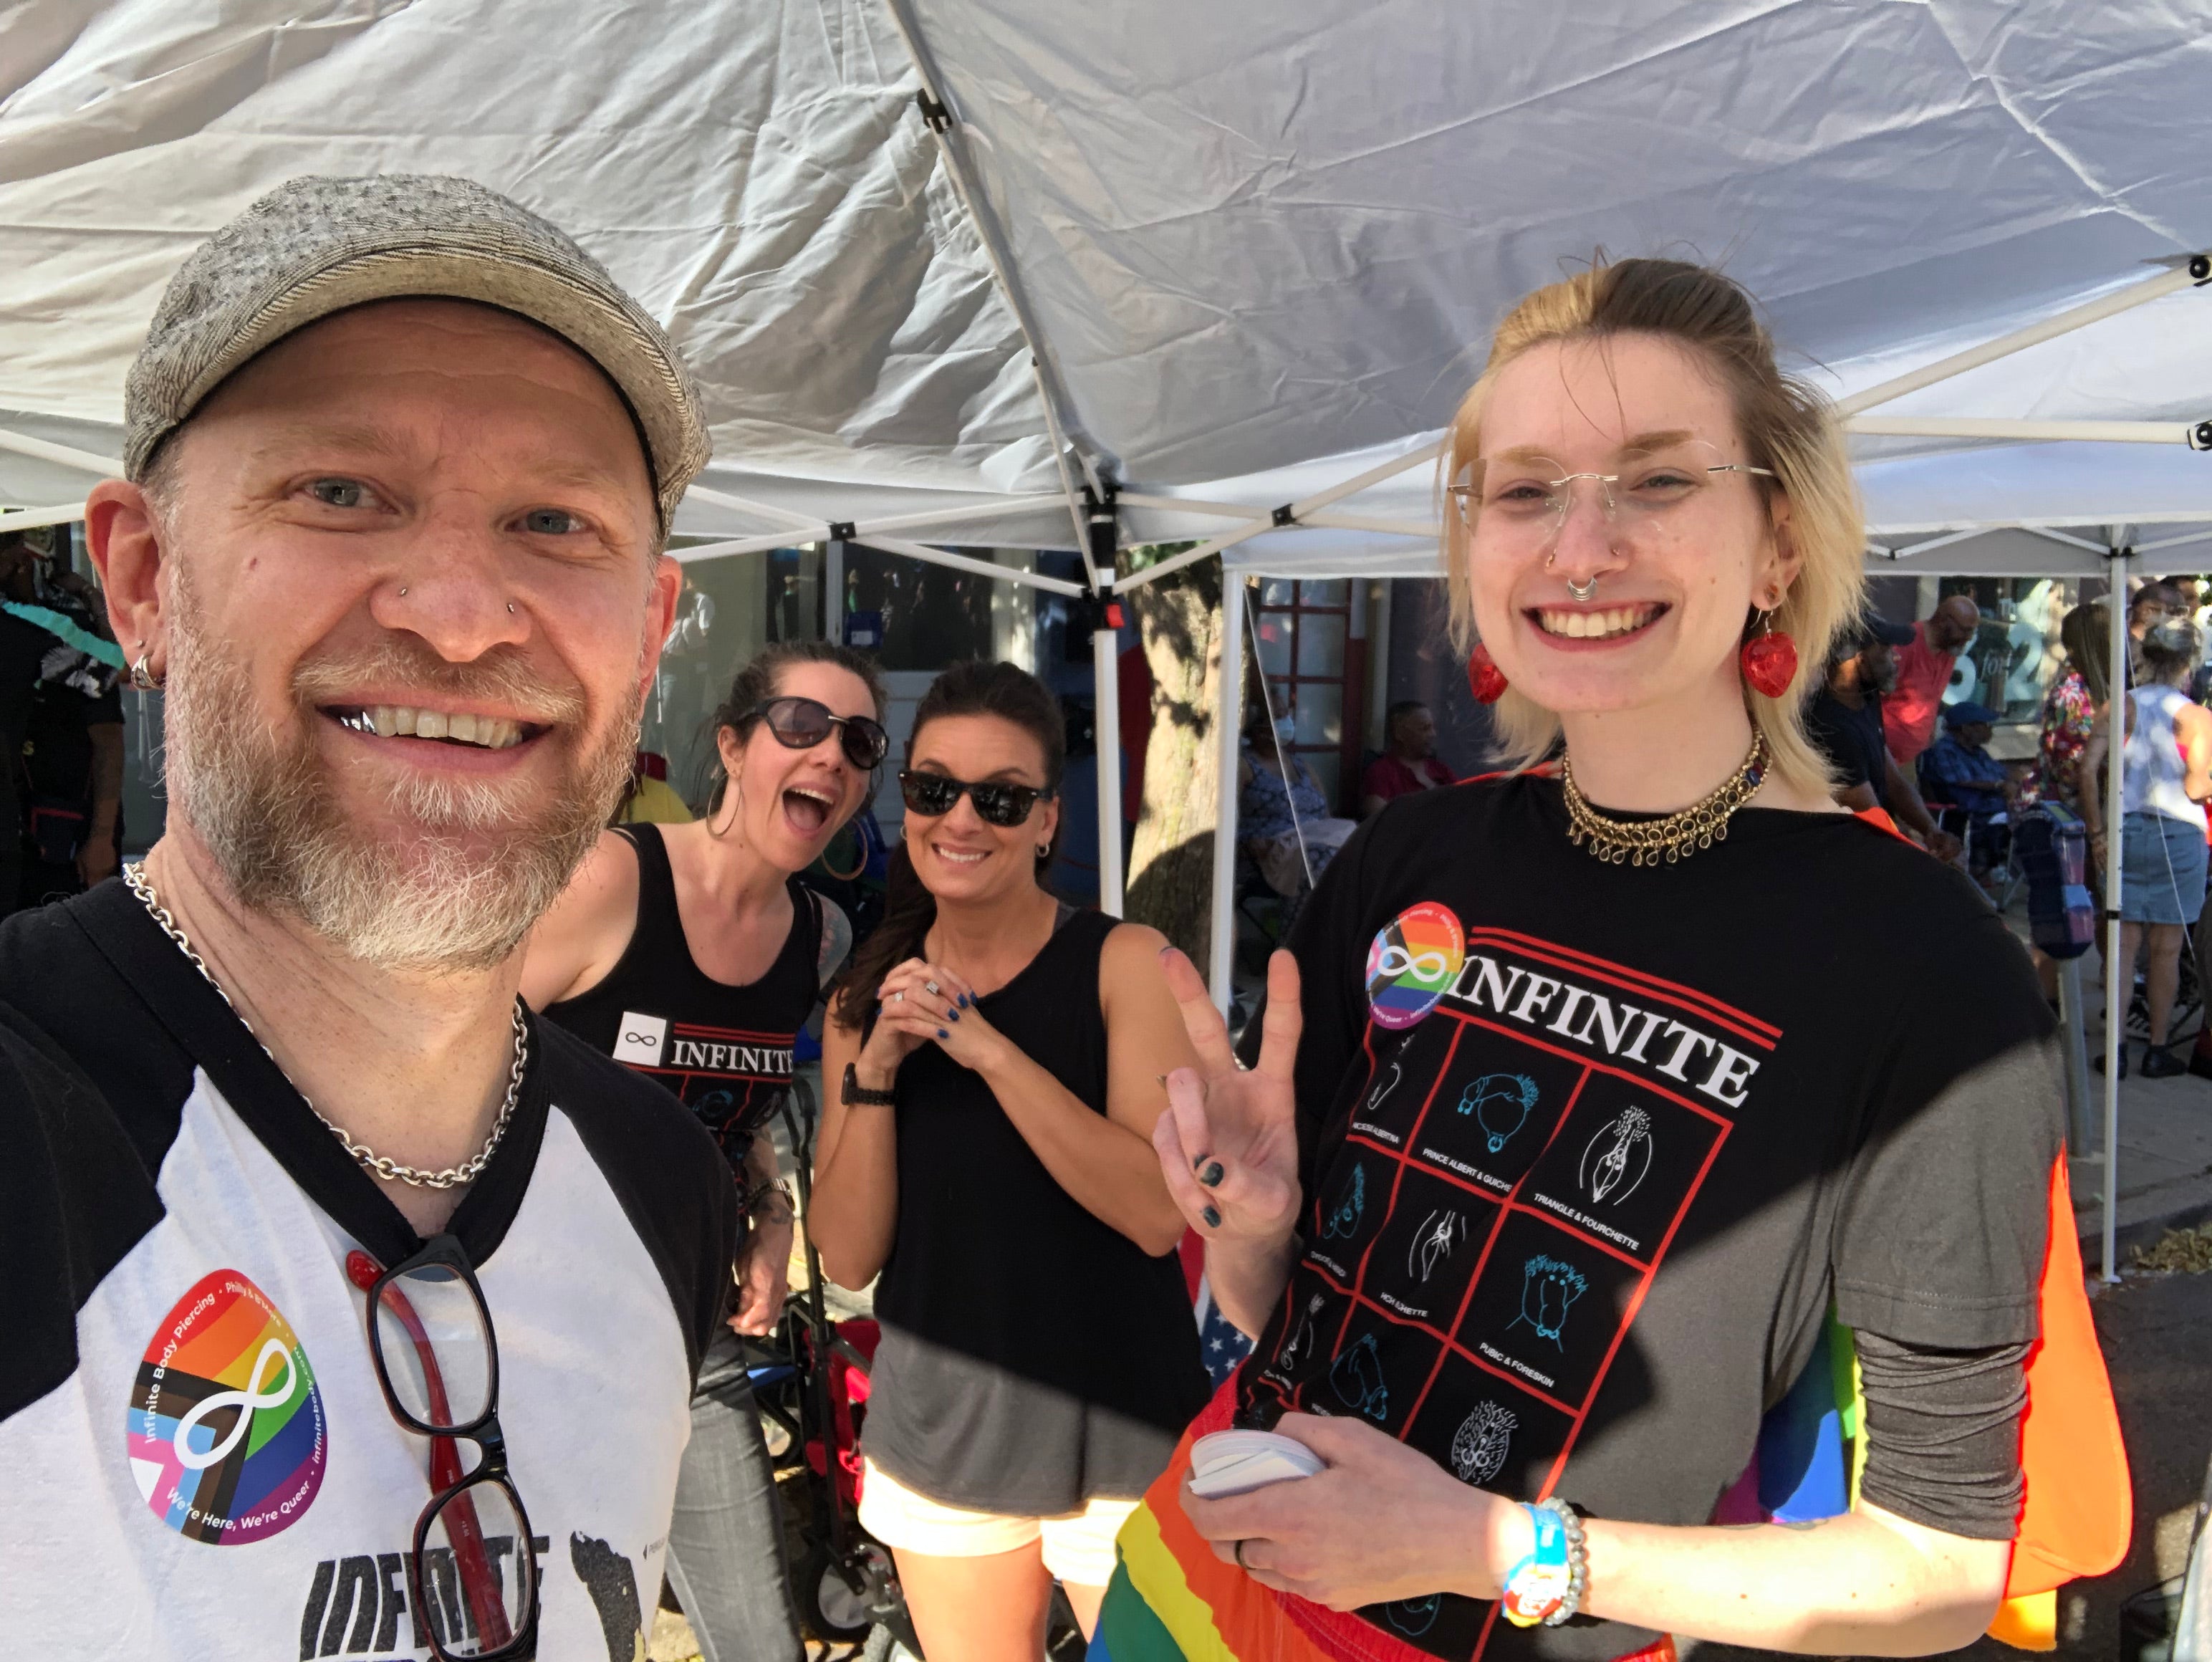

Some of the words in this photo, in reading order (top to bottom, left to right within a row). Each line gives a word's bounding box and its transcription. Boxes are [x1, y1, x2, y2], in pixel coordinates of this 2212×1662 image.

[1443, 954, 1762, 1109] INFINITE
[1423, 1148, 1448, 1166] PRINCE
[1448, 1158, 1477, 1178] ALBERT
[1476, 1171, 1484, 1181] &
[1484, 1174, 1513, 1193] GUICHE
[1534, 1193, 1576, 1219] TRIANGLE
[1574, 1211, 1582, 1222] &
[1582, 1215, 1640, 1251] FOURCHETTE
[144, 1382, 161, 1444] Infinite
[153, 1339, 178, 1380] Body
[173, 1292, 216, 1338] Piercing
[1478, 1342, 1504, 1362] PUBIC
[1504, 1356, 1511, 1366] &
[1511, 1360, 1555, 1388] FORESKIN
[294, 1346, 322, 1465] infinitebody.com
[167, 1486, 201, 1520] We're
[202, 1512, 237, 1532] Here,
[241, 1509, 279, 1530] We're
[279, 1479, 311, 1515] Queer
